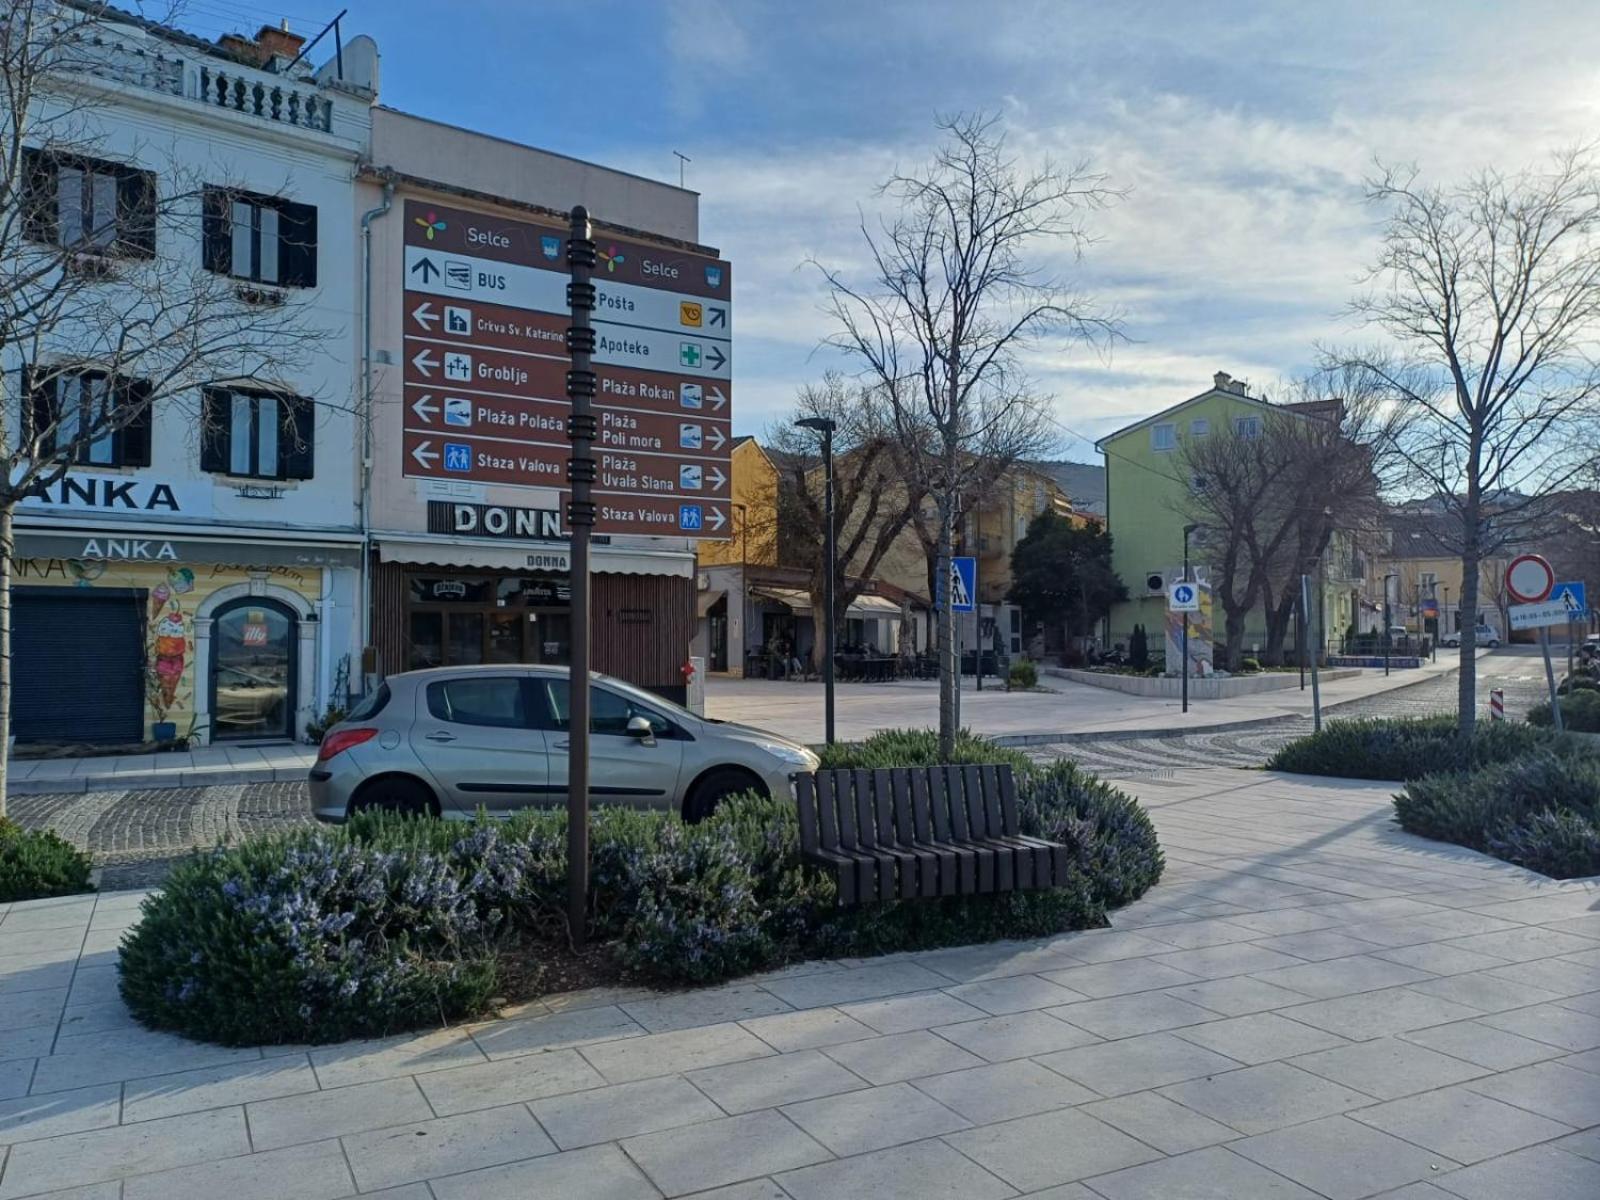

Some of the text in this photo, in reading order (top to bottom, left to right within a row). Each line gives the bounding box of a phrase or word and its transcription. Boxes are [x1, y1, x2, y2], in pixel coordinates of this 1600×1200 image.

[468, 227, 511, 249] Selce
[642, 260, 679, 279] Selce
[478, 273, 506, 290] BUS
[599, 293, 635, 312] Pošta
[478, 318, 564, 343] Crkva Sv. Katarine
[599, 336, 649, 355] Apoteka
[478, 362, 528, 385] Groblje
[602, 378, 675, 400] Plaža Rokan
[478, 408, 516, 426] Plaža
[602, 412, 637, 429] Plaža
[602, 430, 661, 448] Poli mora
[478, 453, 560, 475] Staza Valova
[602, 455, 637, 471] Plaža
[602, 472, 674, 491] Uvala Slana
[22, 475, 181, 511] ANKA
[602, 506, 675, 523] Staza Valova
[82, 538, 178, 560] ANKA
[527, 555, 567, 567] DONNA
